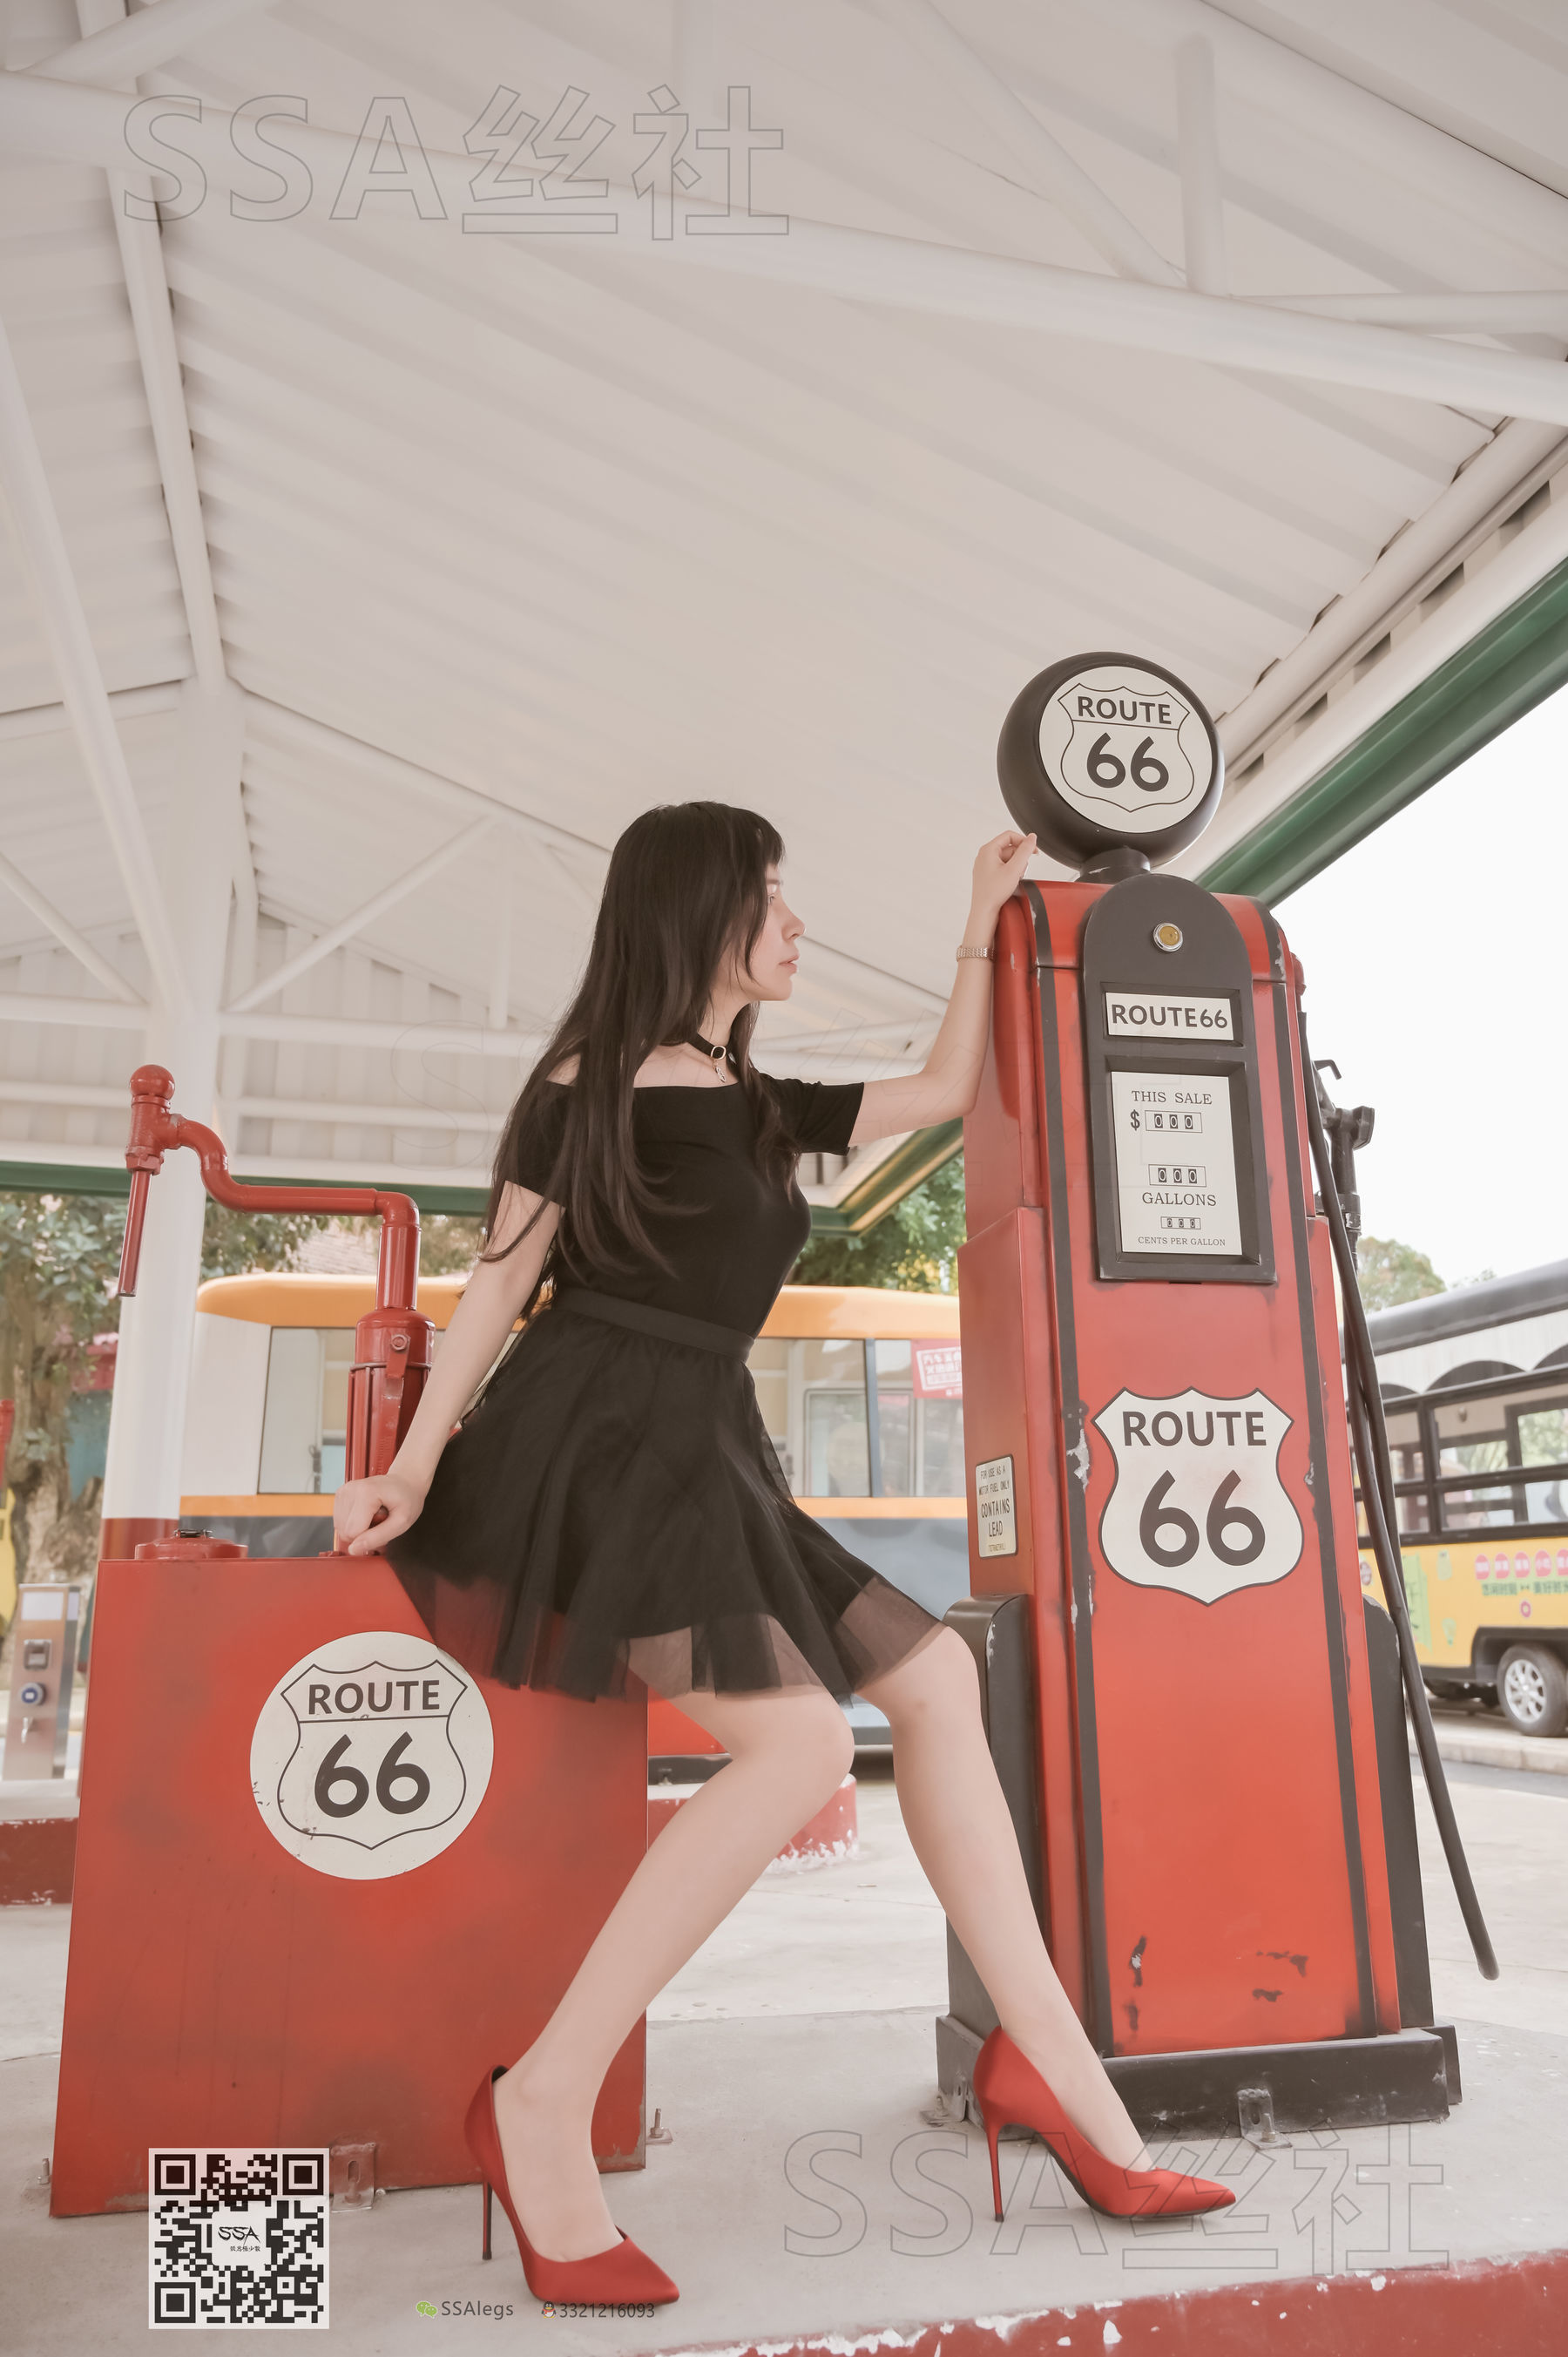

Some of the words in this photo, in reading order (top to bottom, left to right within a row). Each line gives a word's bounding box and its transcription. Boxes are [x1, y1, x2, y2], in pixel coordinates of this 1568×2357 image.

[1077, 695, 1172, 725] ROUTE
[1086, 732, 1169, 792] 66
[1111, 1004, 1228, 1029] ROUTE66
[1132, 1090, 1167, 1103] THIS
[1174, 1092, 1213, 1105] SALE
[1142, 1191, 1217, 1207] GALLONS
[1122, 1410, 1267, 1447] ROUTE
[981, 1498, 1010, 1518] CONTAINS
[1139, 1469, 1266, 1568] 66
[988, 1520, 1004, 1537] LEAD
[308, 1679, 440, 1715] ROUTE
[314, 1731, 430, 1818] 66
